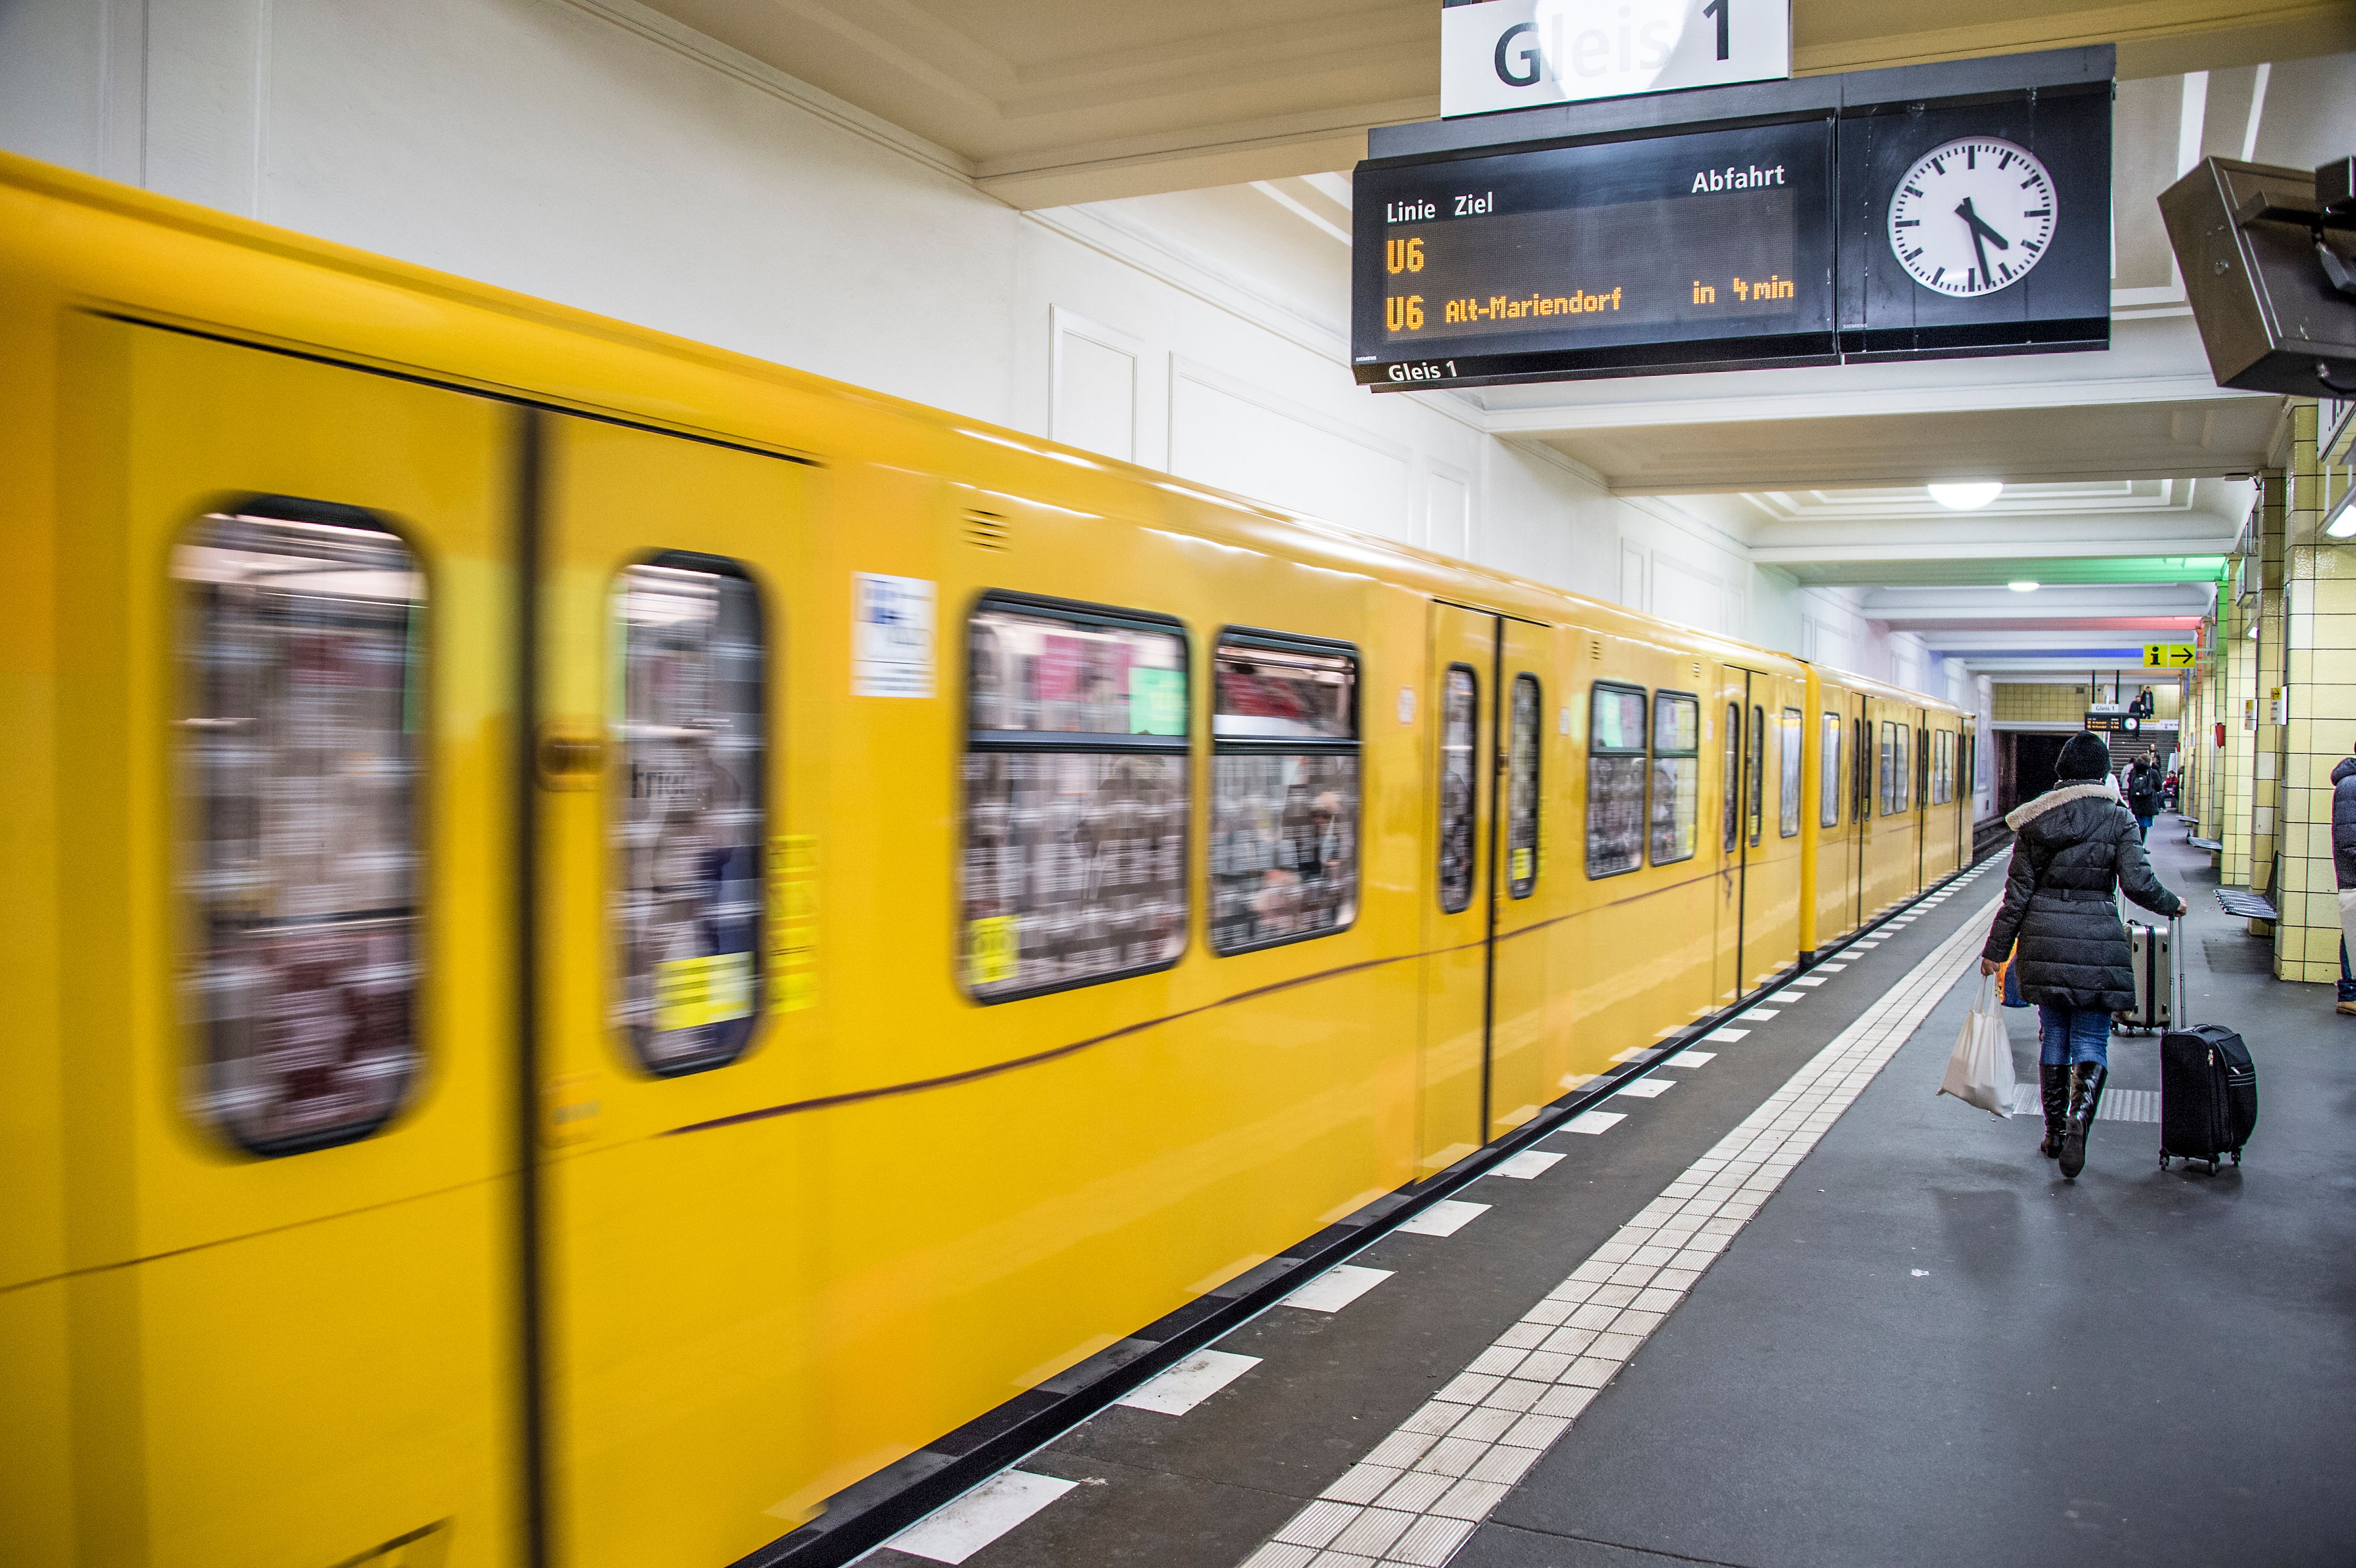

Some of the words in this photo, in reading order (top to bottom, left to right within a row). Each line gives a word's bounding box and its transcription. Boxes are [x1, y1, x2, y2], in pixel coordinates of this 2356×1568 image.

[1494, 6, 1671, 87] Gleis
[1703, 0, 1729, 61] 1
[1387, 199, 1436, 223] Linie
[1455, 191, 1493, 216] Ziel
[1691, 165, 1785, 193] Abfahrt
[1387, 237, 1424, 274] U6
[1386, 295, 1424, 331] U6
[1445, 287, 1622, 323] Alt-Mariendorf
[1693, 280, 1716, 304] in
[1733, 277, 1749, 301] 4
[1753, 275, 1794, 300] min
[1389, 362, 1441, 381] Gleis
[1446, 360, 1458, 377] 1
